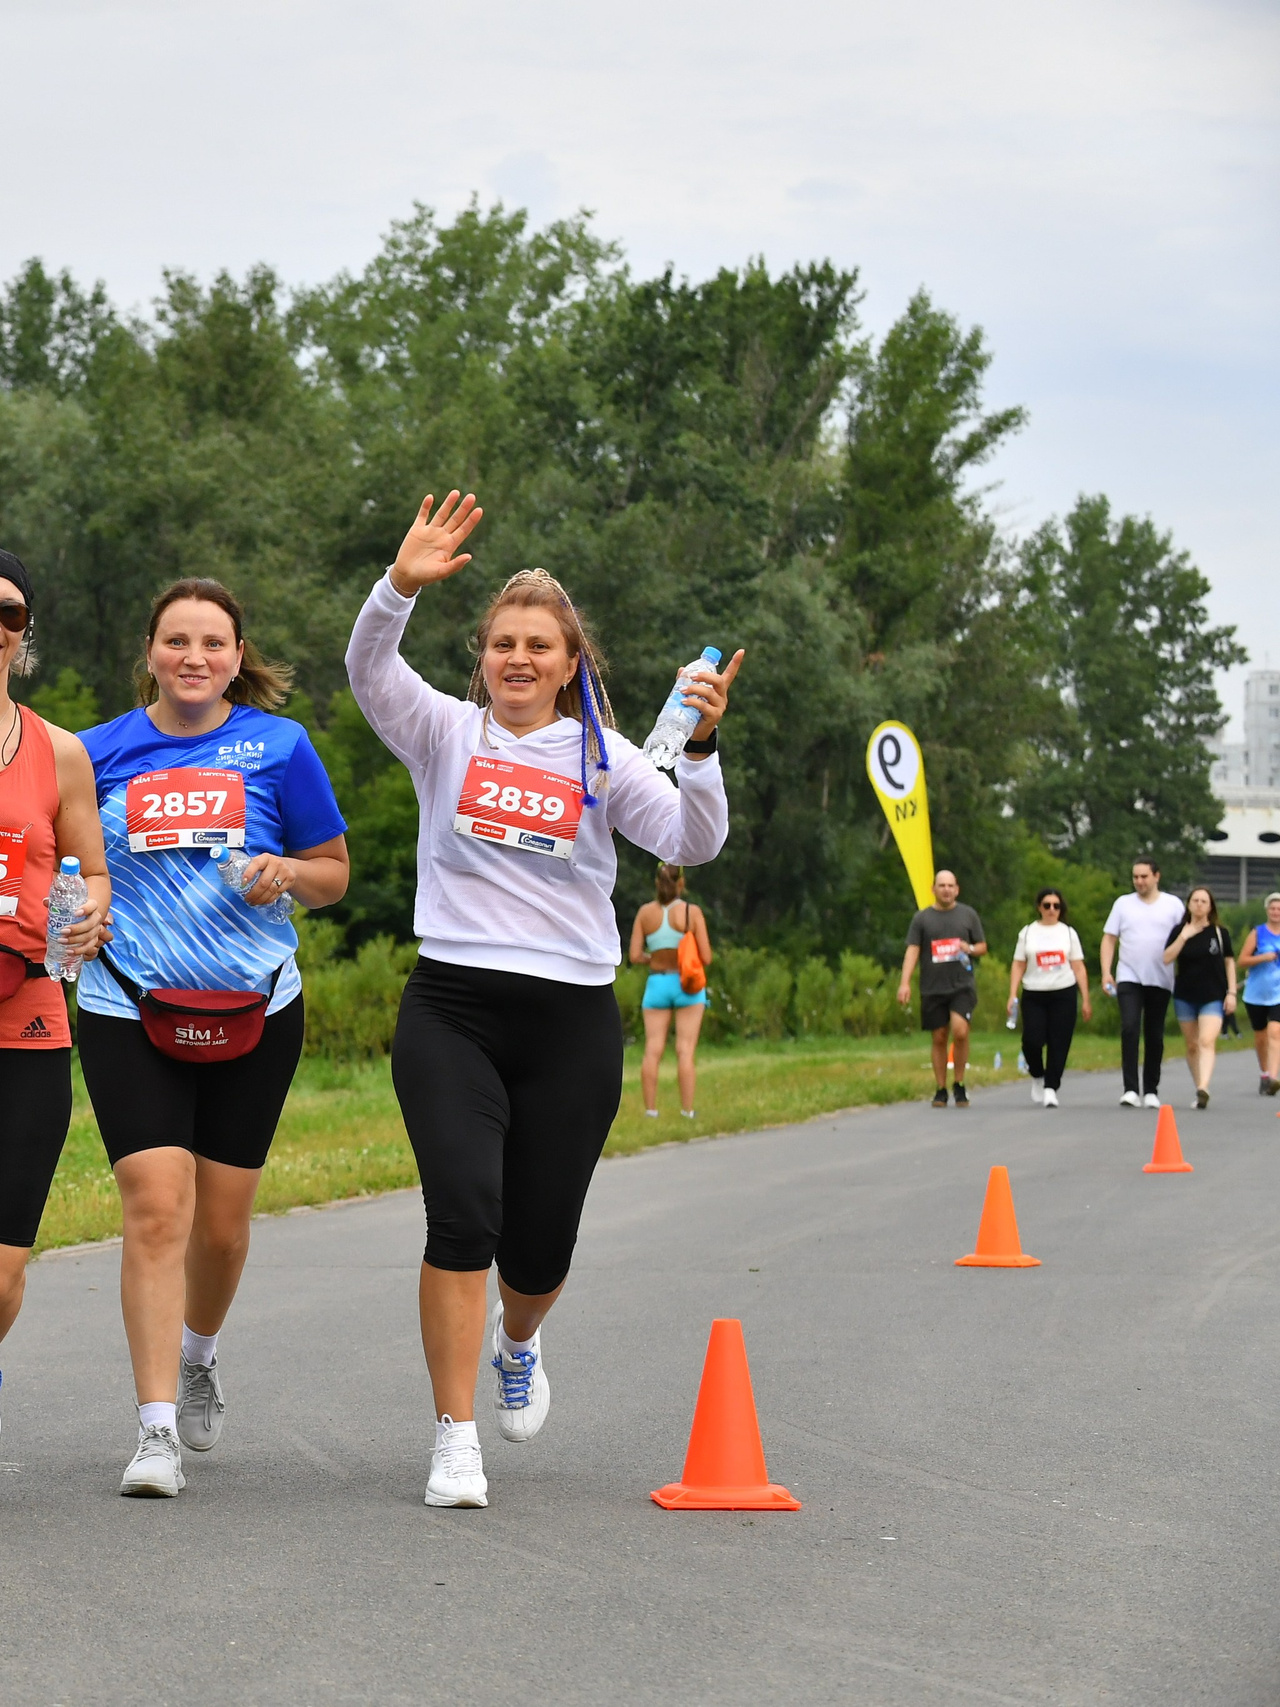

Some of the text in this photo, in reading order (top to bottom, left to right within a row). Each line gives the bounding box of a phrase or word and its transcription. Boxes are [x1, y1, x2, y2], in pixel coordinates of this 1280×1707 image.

[141, 791, 228, 819] 2857
[476, 781, 565, 822] 2839
[20, 1030, 52, 1038] adidas
[174, 1038, 229, 1046] ЦВЕТОЧНЫЙ ЗАБЕГ
